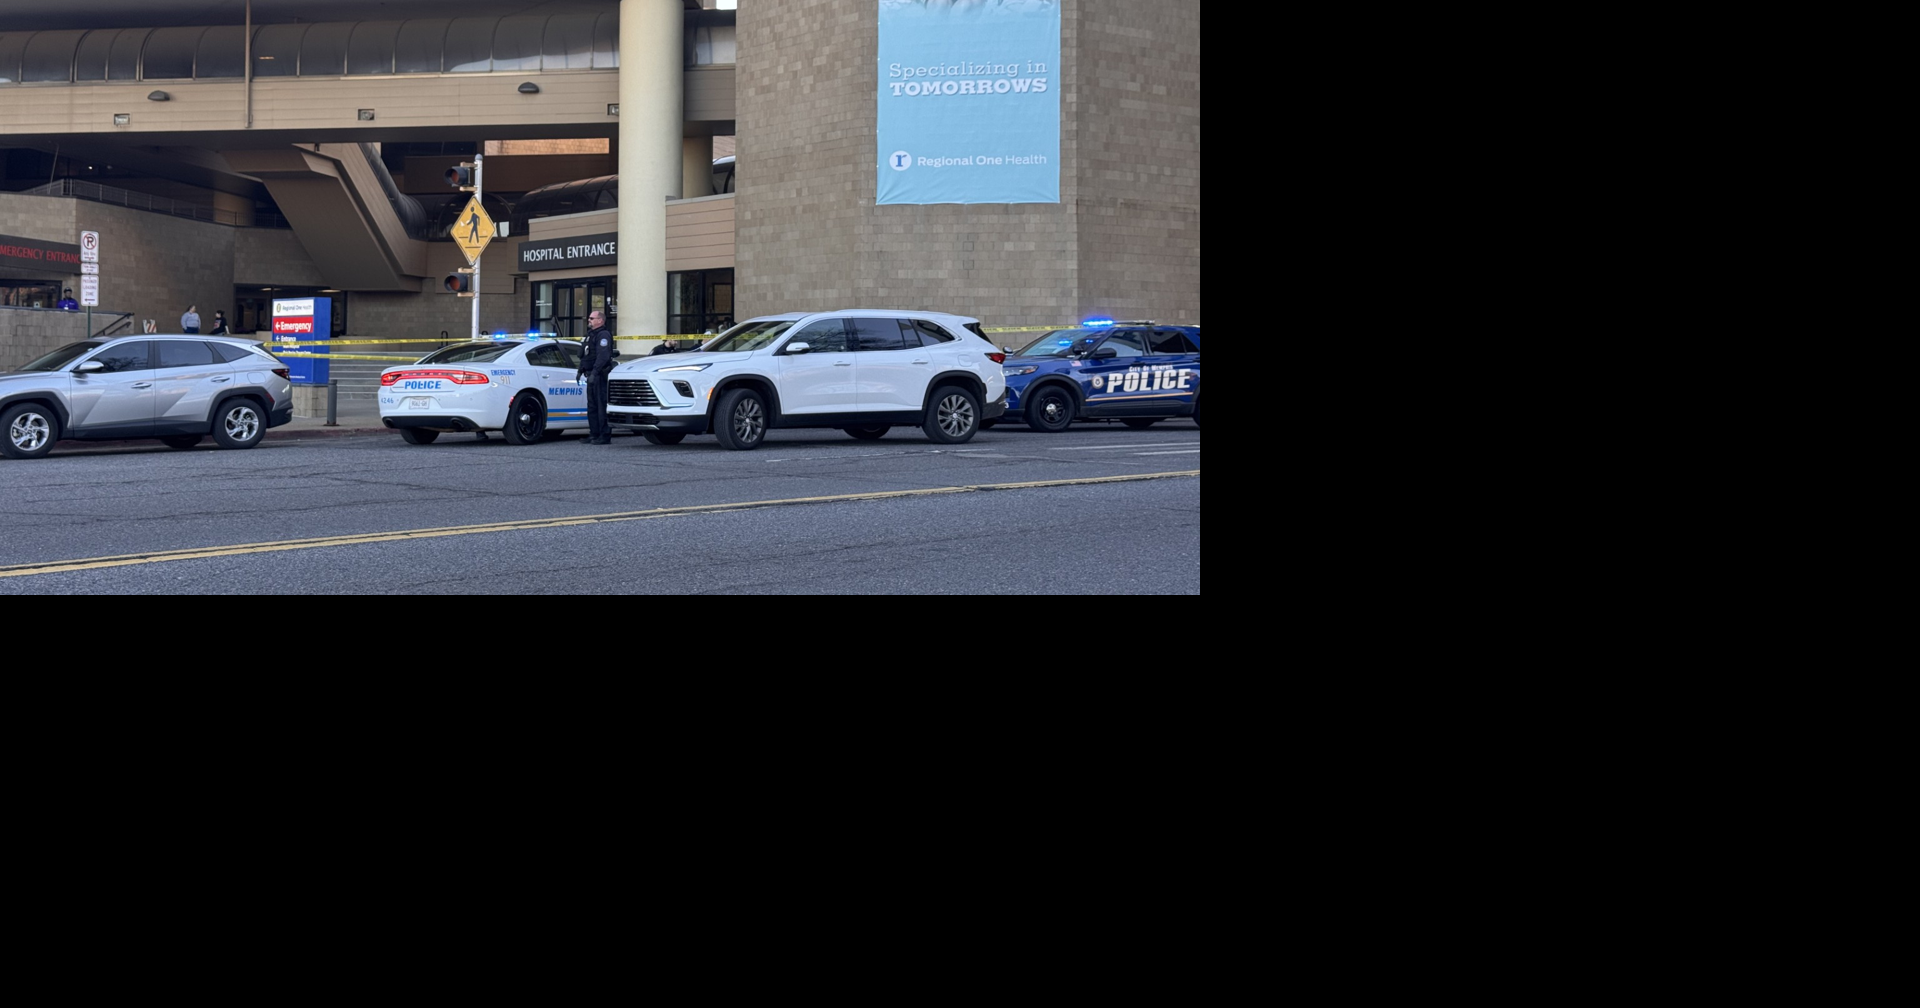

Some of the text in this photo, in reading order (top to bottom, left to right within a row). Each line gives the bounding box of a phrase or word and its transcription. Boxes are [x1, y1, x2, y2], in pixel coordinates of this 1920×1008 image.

[889, 60, 1048, 81] Specializing in
[889, 77, 1048, 97] TOMORROWS
[917, 156, 973, 168] Regional
[975, 155, 1002, 166] One
[1005, 154, 1047, 165] Health
[0, 245, 82, 264] MERGENCY ENTRANC
[523, 242, 616, 262] HOSPITAL ENTRANCE
[280, 321, 312, 333] Emergency
[404, 380, 442, 390] POLICE
[500, 376, 511, 385] 911
[1106, 368, 1191, 394] POLICE
[548, 387, 583, 396] MEMPHIS
